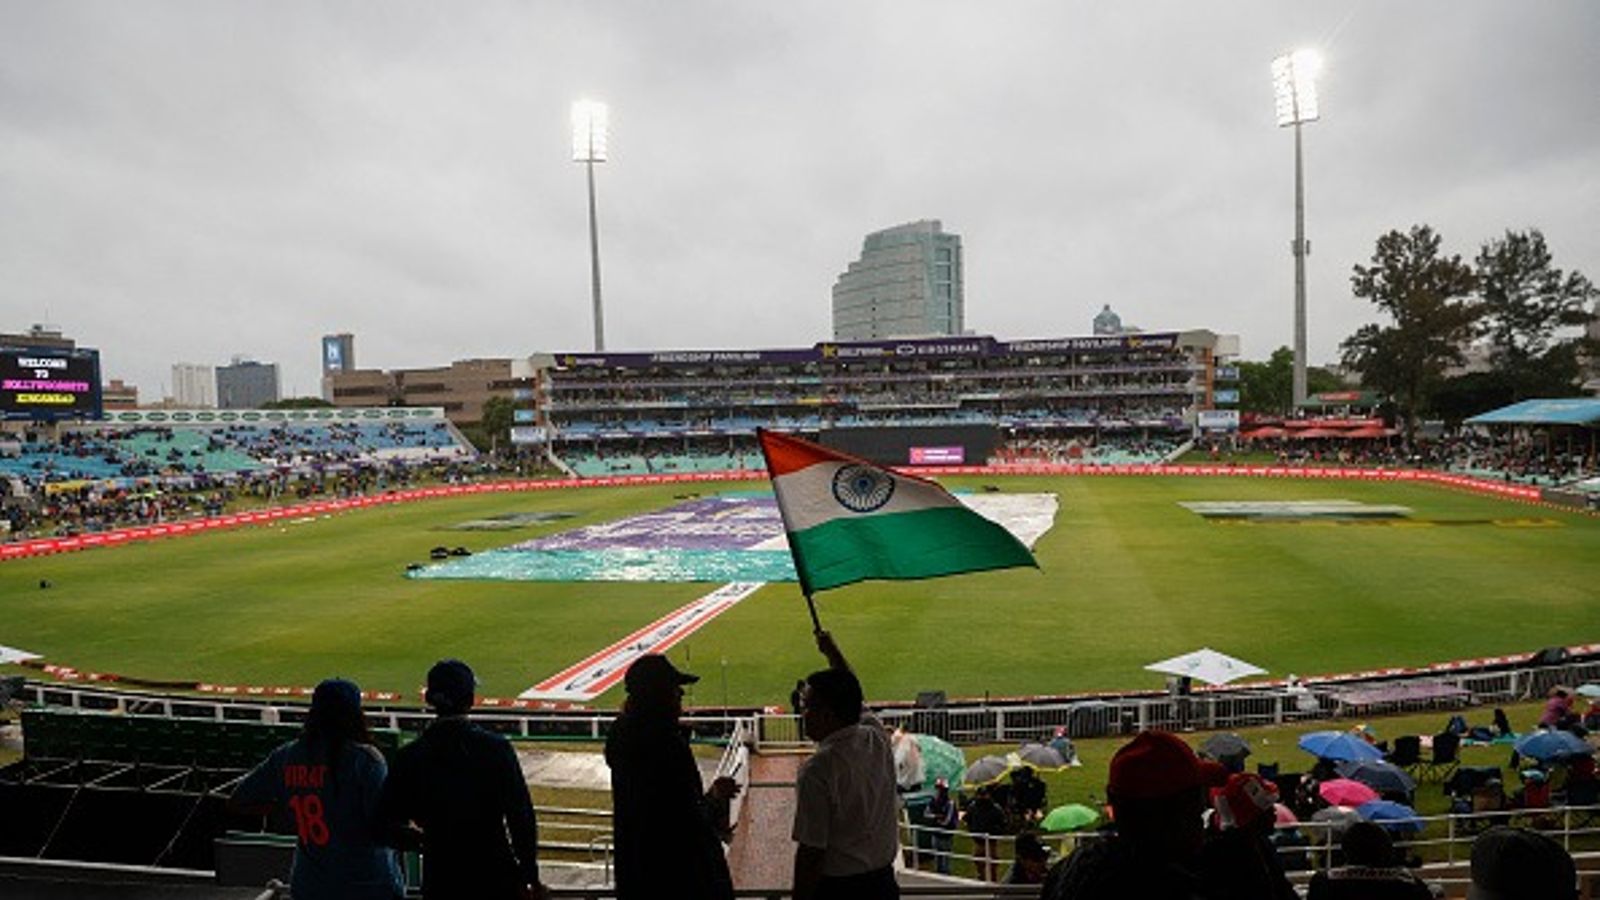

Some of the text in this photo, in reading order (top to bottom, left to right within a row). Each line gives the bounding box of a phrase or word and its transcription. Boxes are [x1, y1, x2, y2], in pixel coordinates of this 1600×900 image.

[18, 358, 67, 369] WELCOME
[34, 369, 49, 378] TO
[284, 765, 326, 788] VIRAT
[290, 794, 330, 847] 18
